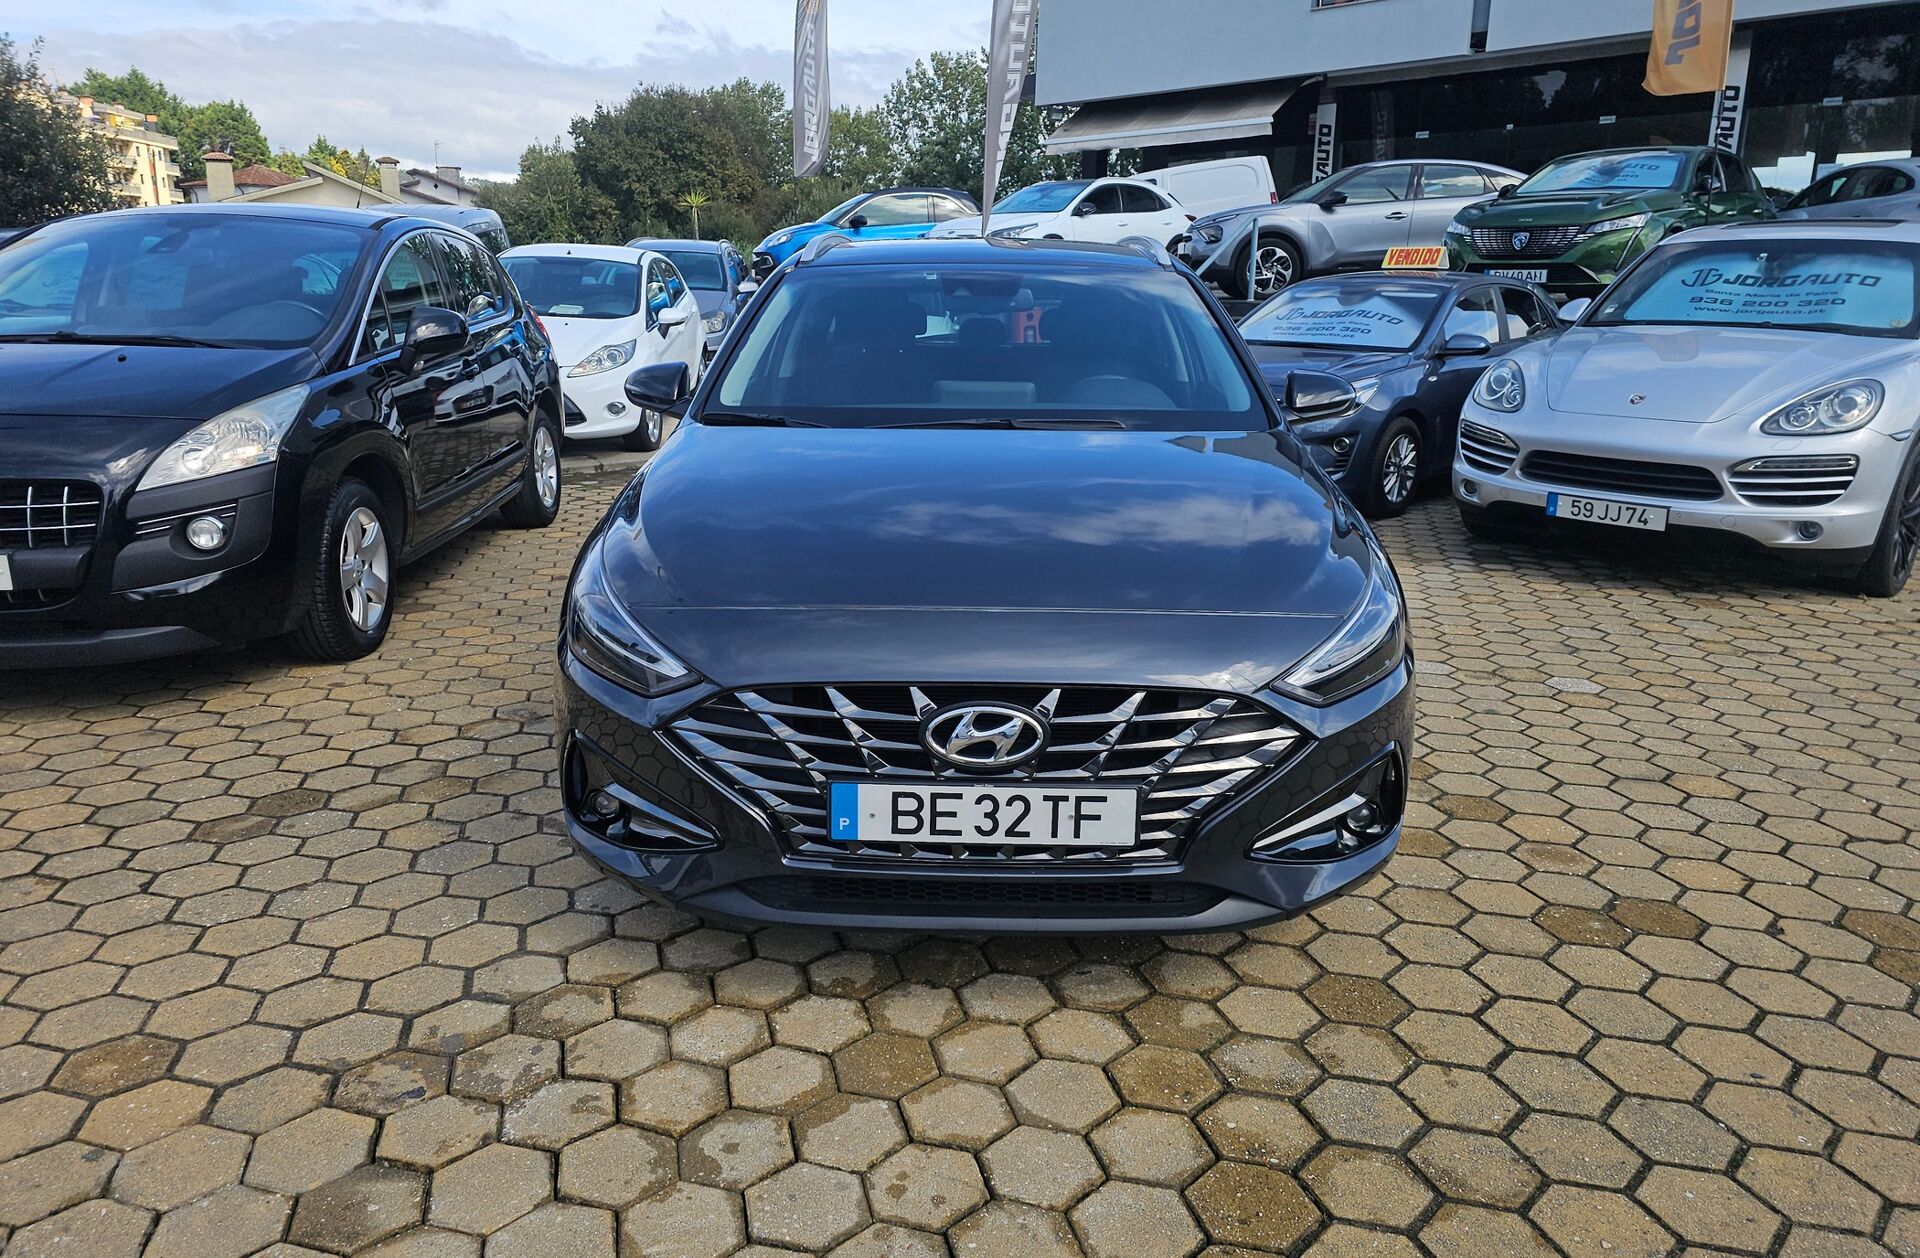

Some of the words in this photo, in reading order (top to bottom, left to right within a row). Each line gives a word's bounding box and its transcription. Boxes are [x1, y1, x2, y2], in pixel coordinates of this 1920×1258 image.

[1388, 248, 1441, 265] VENDIDO
[1722, 273, 1882, 288] JORGAUTO
[1705, 289, 1741, 297] Santa
[1689, 296, 1734, 306] 936
[1797, 298, 1846, 307] 320
[1301, 309, 1404, 325] JORGAUTO
[1694, 306, 1826, 315] www.jorgauto.pt
[1340, 326, 1371, 334] 320
[1570, 499, 1594, 518] 59
[1625, 507, 1649, 526] 74
[891, 791, 964, 836] BE
[974, 793, 1032, 838] 32
[1042, 795, 1108, 839] TF
[839, 818, 850, 830] P
